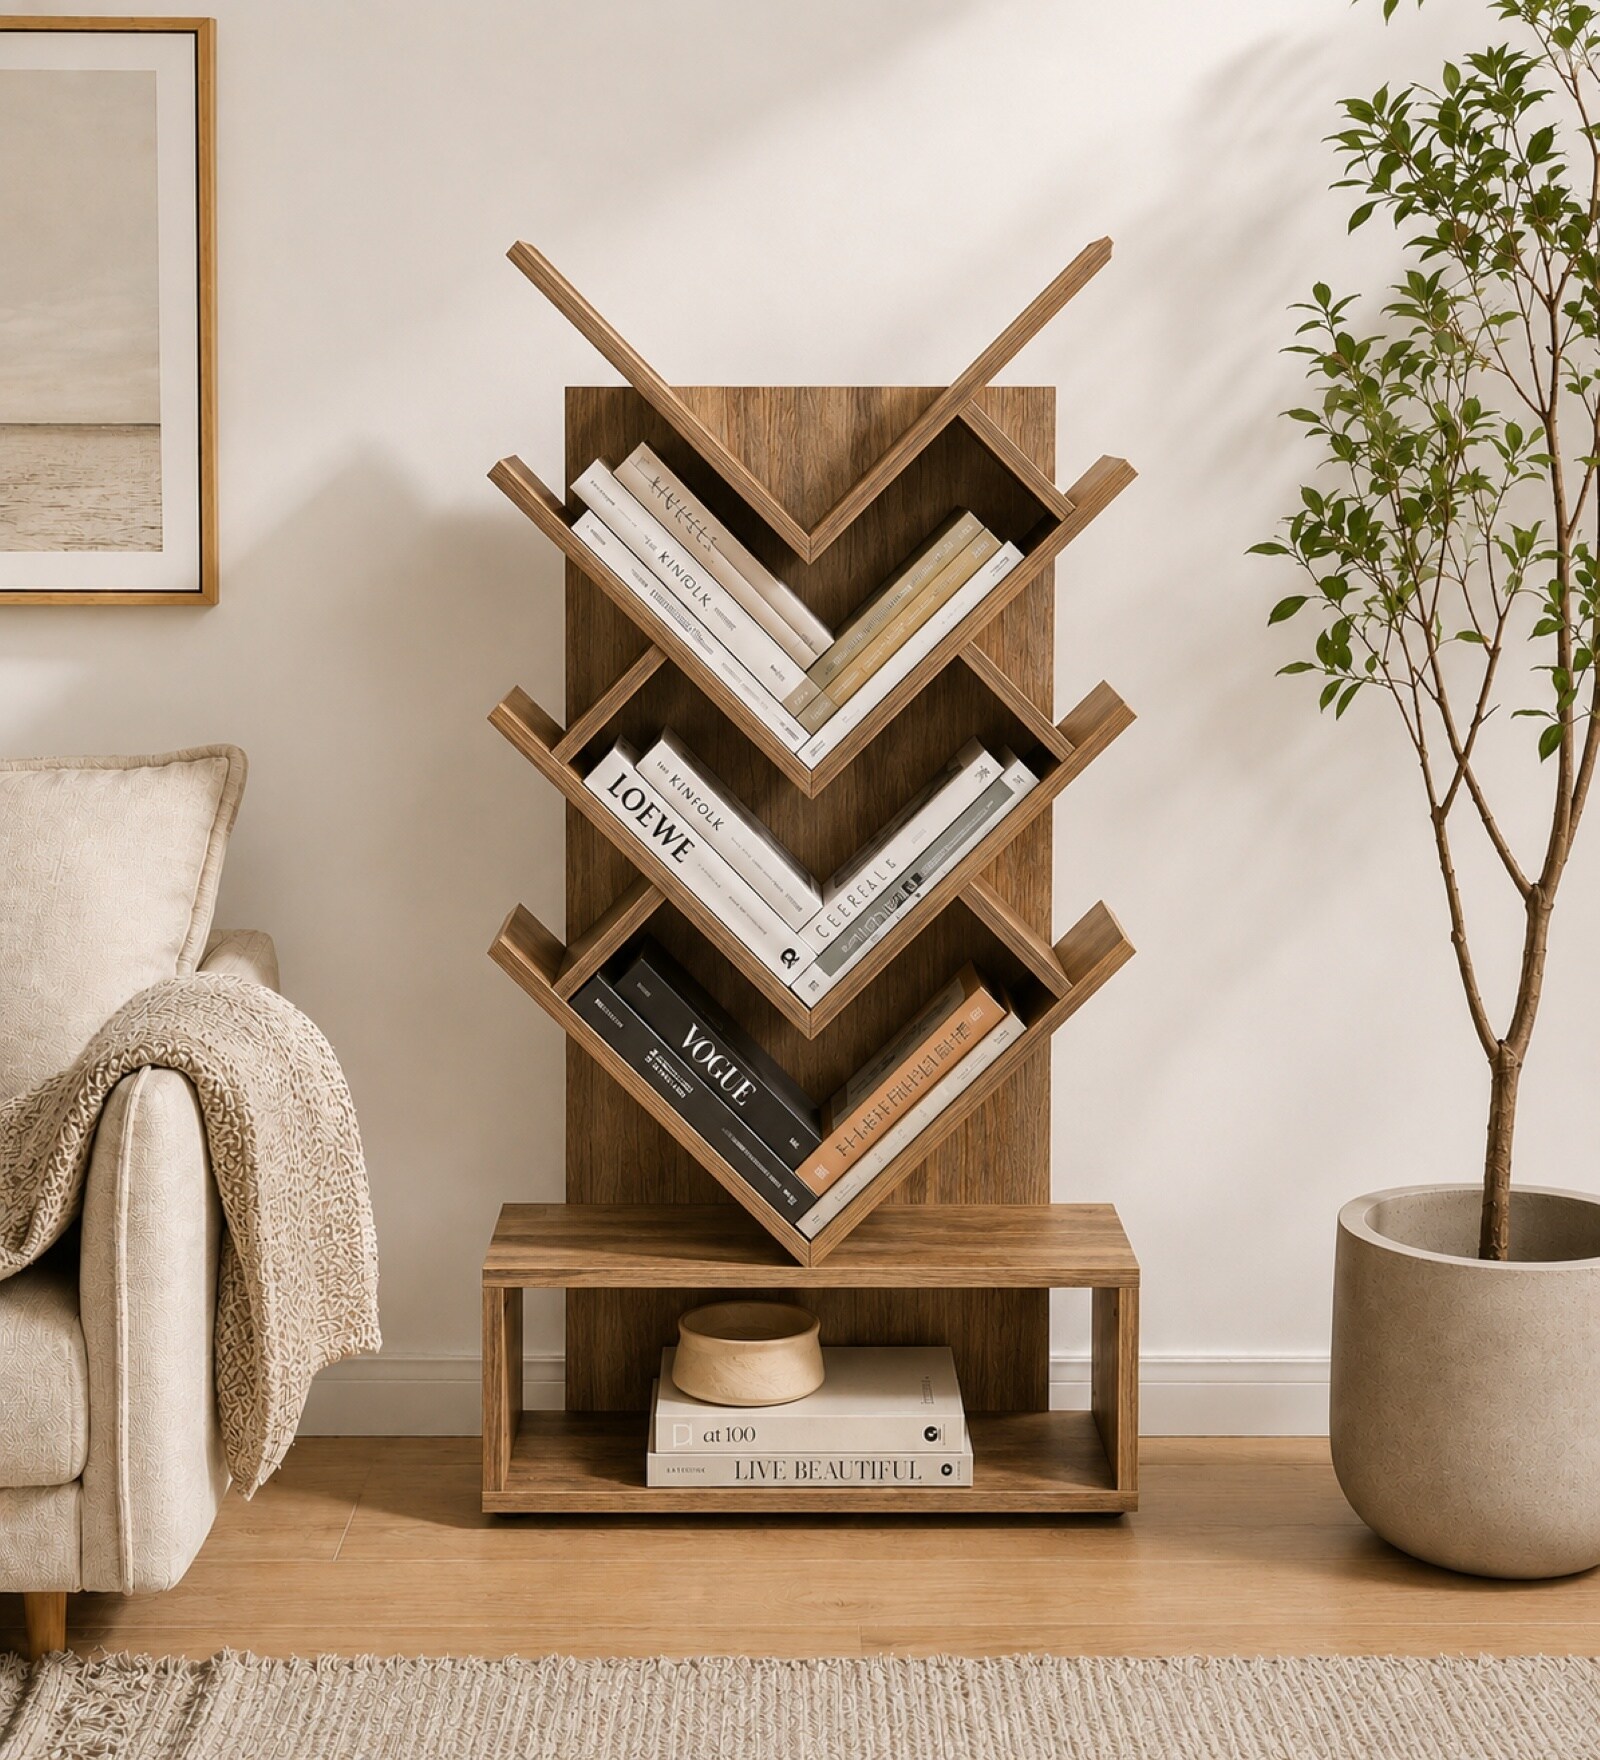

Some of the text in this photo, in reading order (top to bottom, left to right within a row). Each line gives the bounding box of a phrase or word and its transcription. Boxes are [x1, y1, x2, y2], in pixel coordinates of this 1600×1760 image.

[607, 772, 696, 864] LOEWE
[668, 774, 725, 831] KINFOLK
[682, 1022, 757, 1107] VOGUE
[703, 1426, 756, 1443] at 100
[735, 1460, 922, 1480] LIVE BEAUTIFUL
